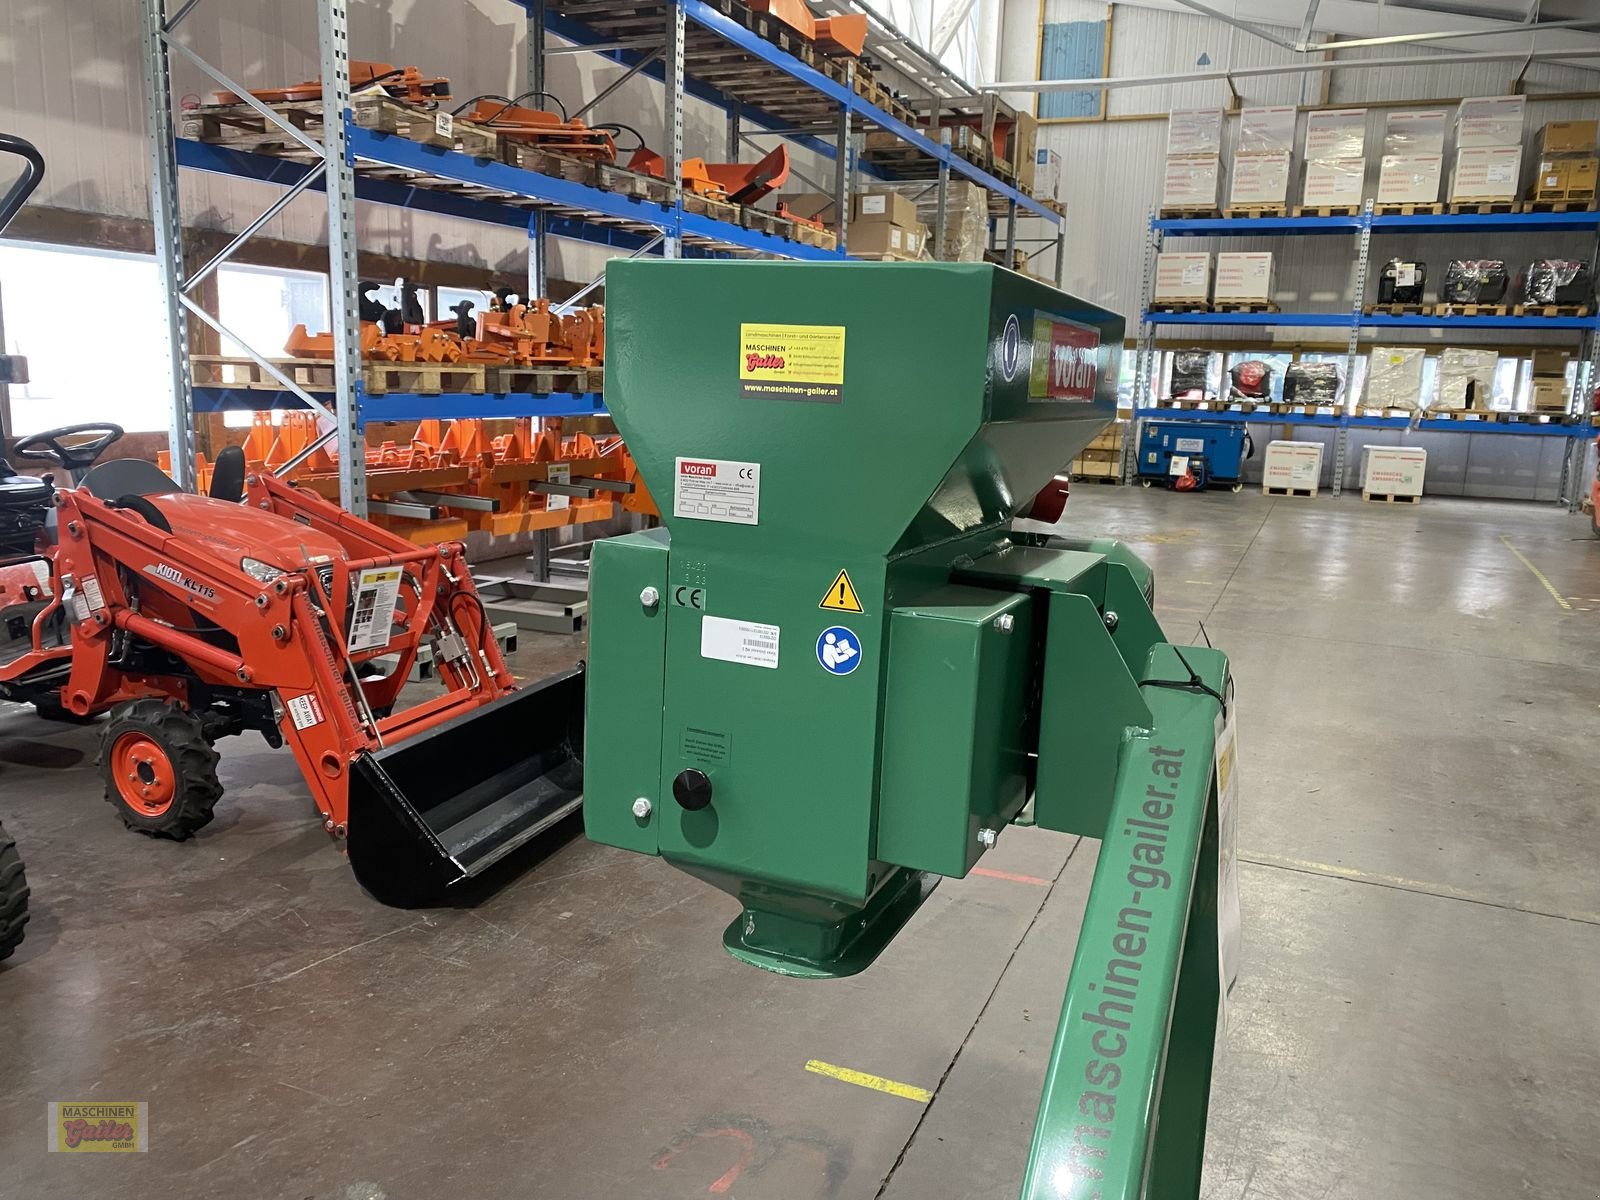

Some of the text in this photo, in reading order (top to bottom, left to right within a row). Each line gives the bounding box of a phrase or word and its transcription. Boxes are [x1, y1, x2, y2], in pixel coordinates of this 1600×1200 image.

[746, 344, 786, 352] MASCHINEN
[744, 384, 838, 397] www.maschinen-gailer.at
[684, 464, 712, 475] voran
[738, 468, 753, 480] CE
[156, 562, 215, 598] KIOTI KL115
[675, 586, 702, 609] CE
[299, 697, 314, 725] KEEP AWAY
